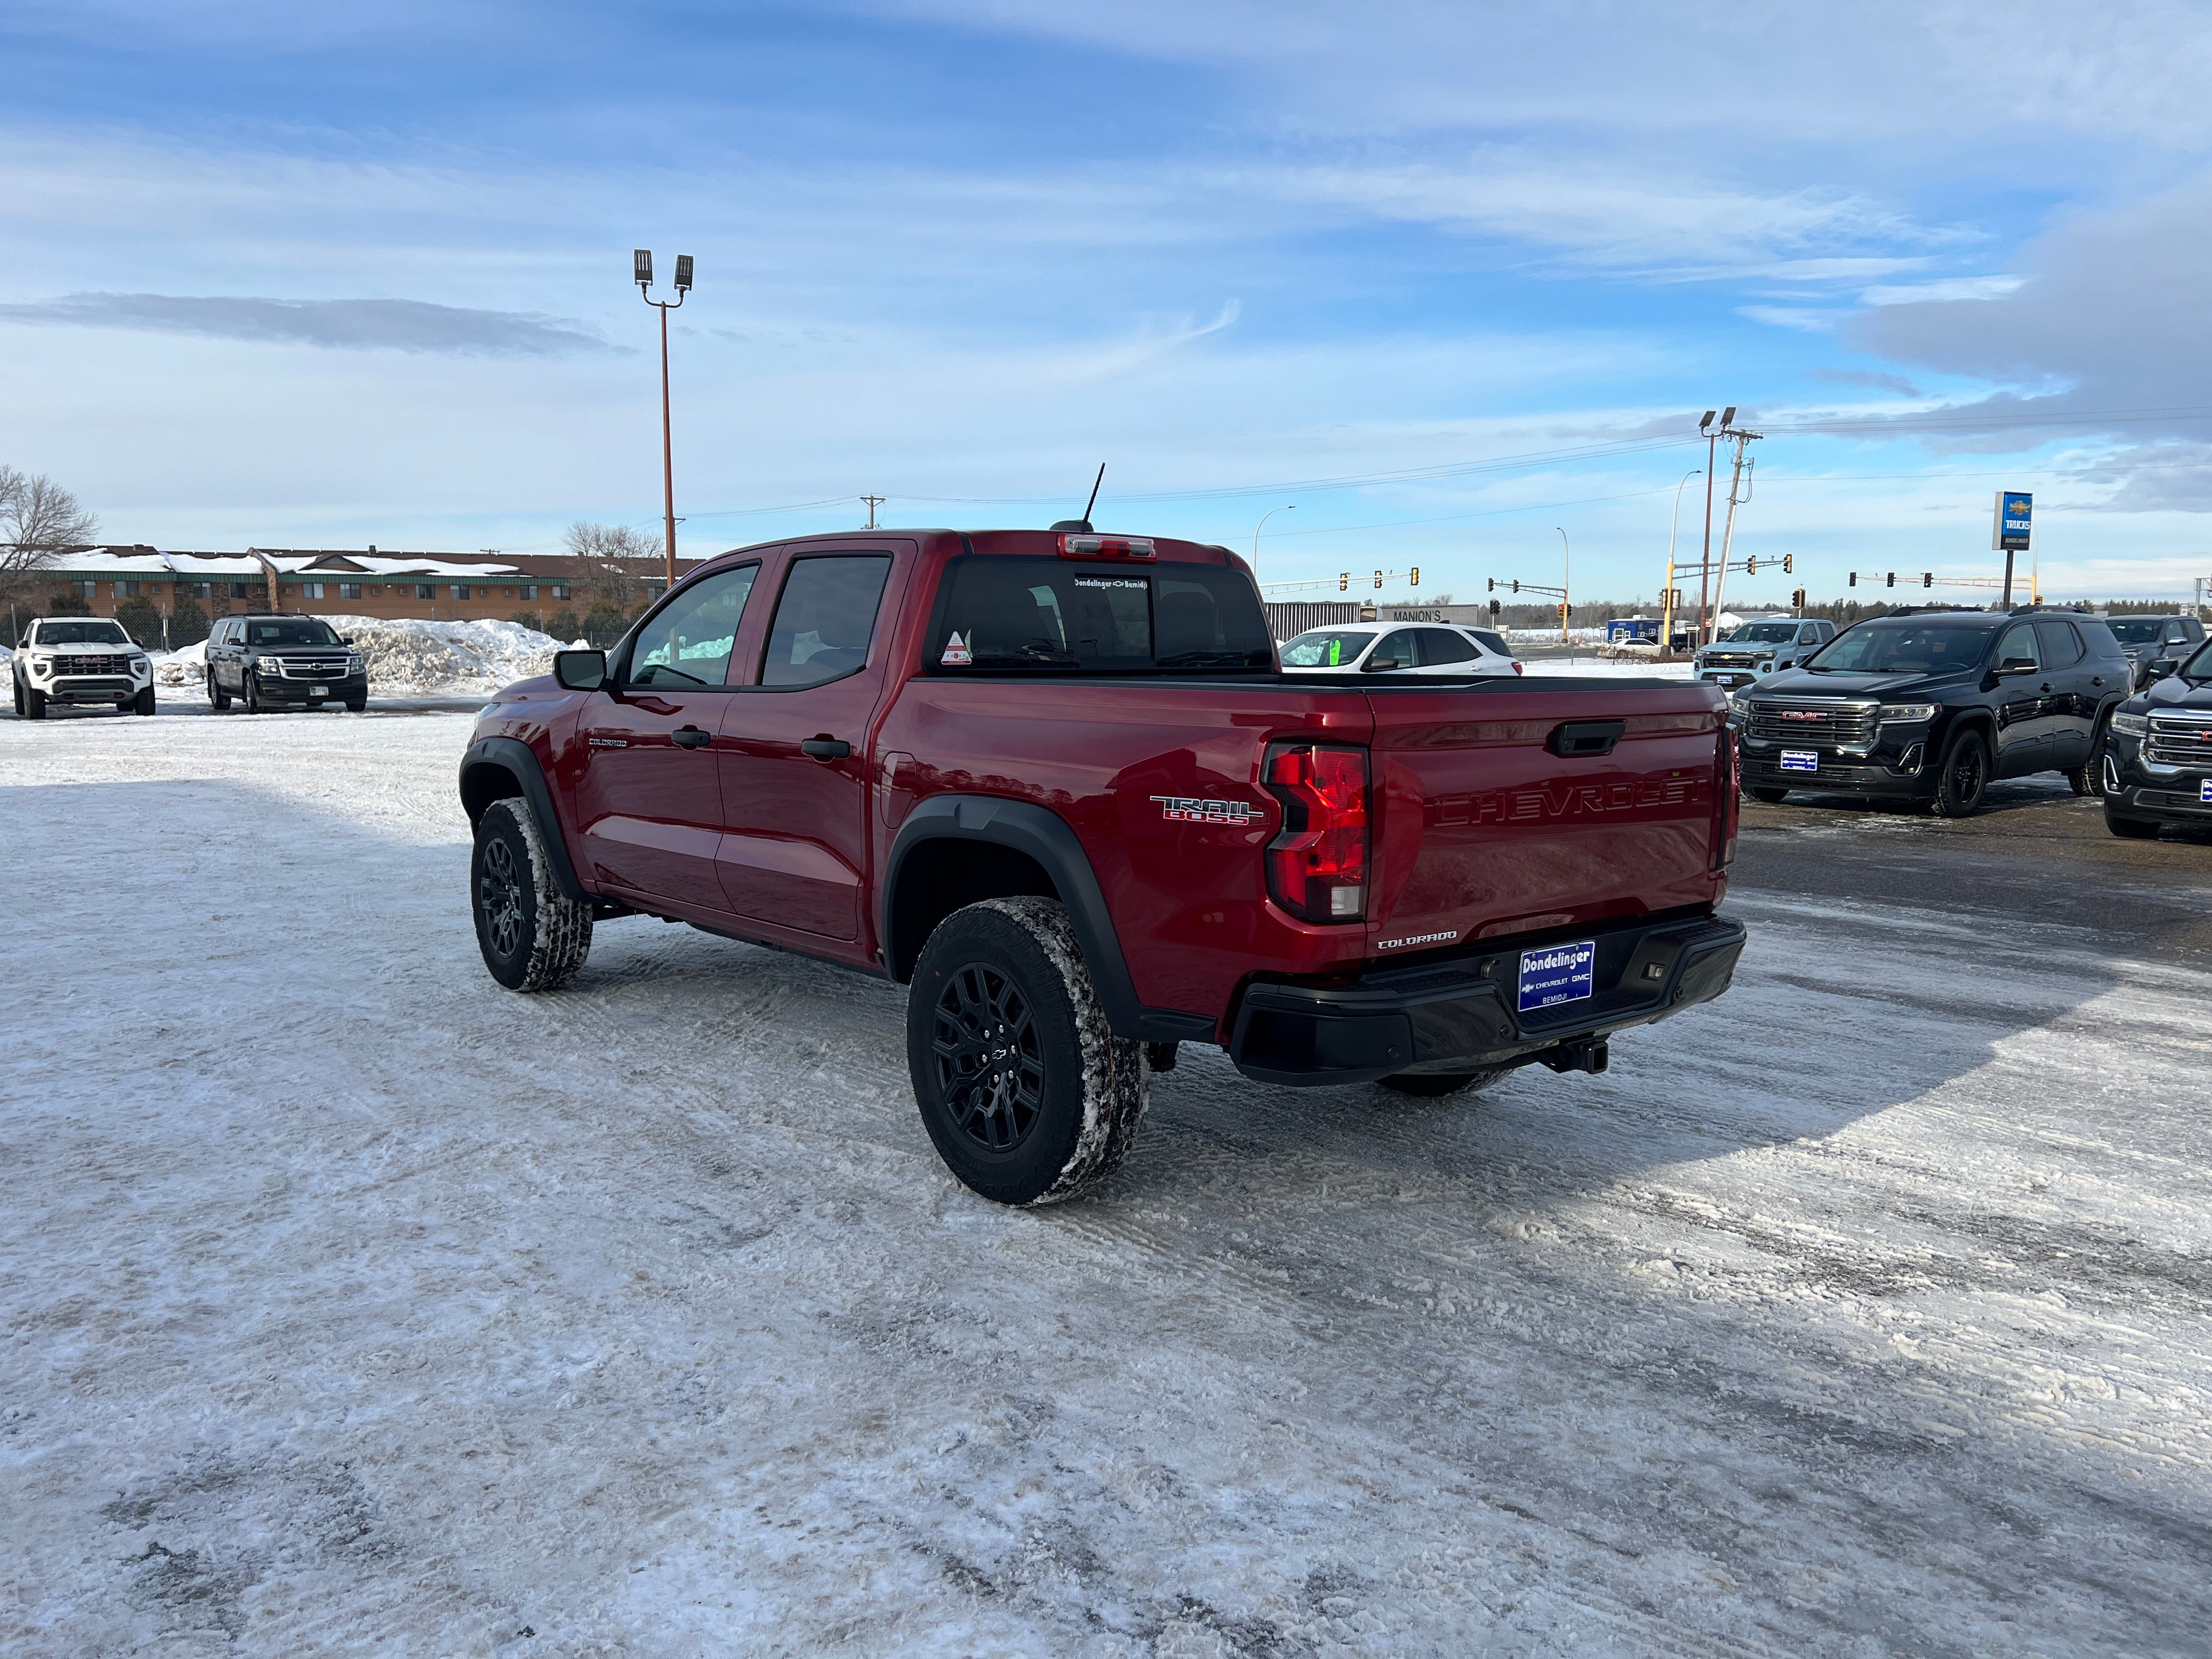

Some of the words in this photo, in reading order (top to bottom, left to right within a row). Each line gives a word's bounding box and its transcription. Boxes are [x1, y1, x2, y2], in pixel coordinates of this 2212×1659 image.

[2006, 520, 2030, 530] TRUCKS
[1075, 579, 1111, 590] Dondelinger
[1125, 580, 1148, 590] Bemidji
[1393, 610, 1441, 622] MANION'S
[1782, 710, 1827, 721] GMC
[589, 738, 627, 747] COLORADO
[1150, 795, 1263, 817] TRAIL
[1434, 776, 1708, 827] CHEVROLET
[1163, 809, 1249, 826] BOSS
[1378, 930, 1457, 949] COLORADO
[1522, 951, 1590, 974] Dondelinger
[1536, 978, 1568, 989] CHEVROLET
[1572, 973, 1590, 983] GMC
[1542, 993, 1567, 1005] BEMIDJI
